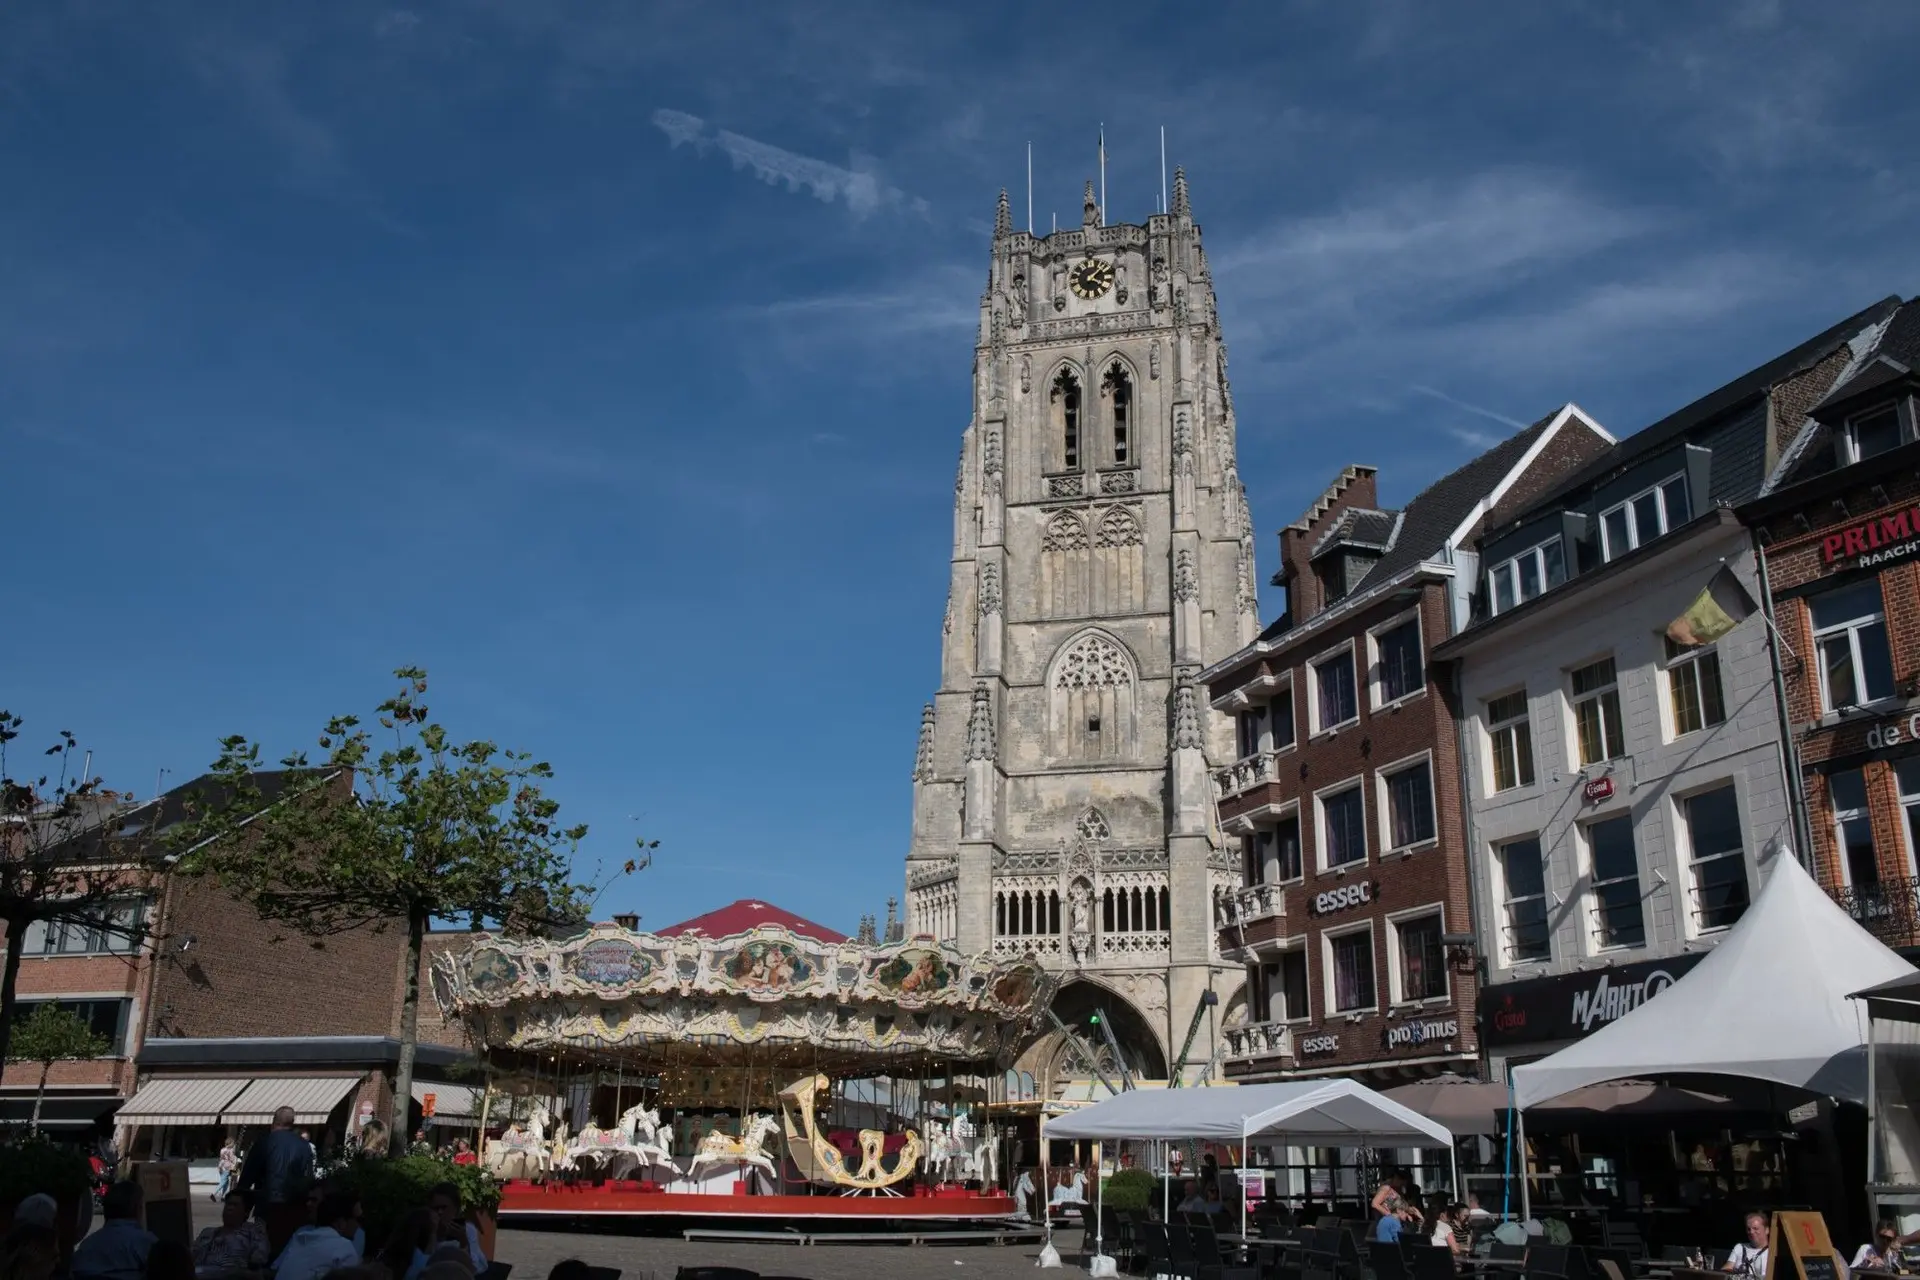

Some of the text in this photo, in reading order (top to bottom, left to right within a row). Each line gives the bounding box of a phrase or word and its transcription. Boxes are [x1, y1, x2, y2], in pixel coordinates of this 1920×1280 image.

[1867, 723, 1900, 750] de
[1316, 880, 1371, 913] essec
[1302, 1034, 1339, 1053] essec
[1388, 1020, 1457, 1049] proximus
